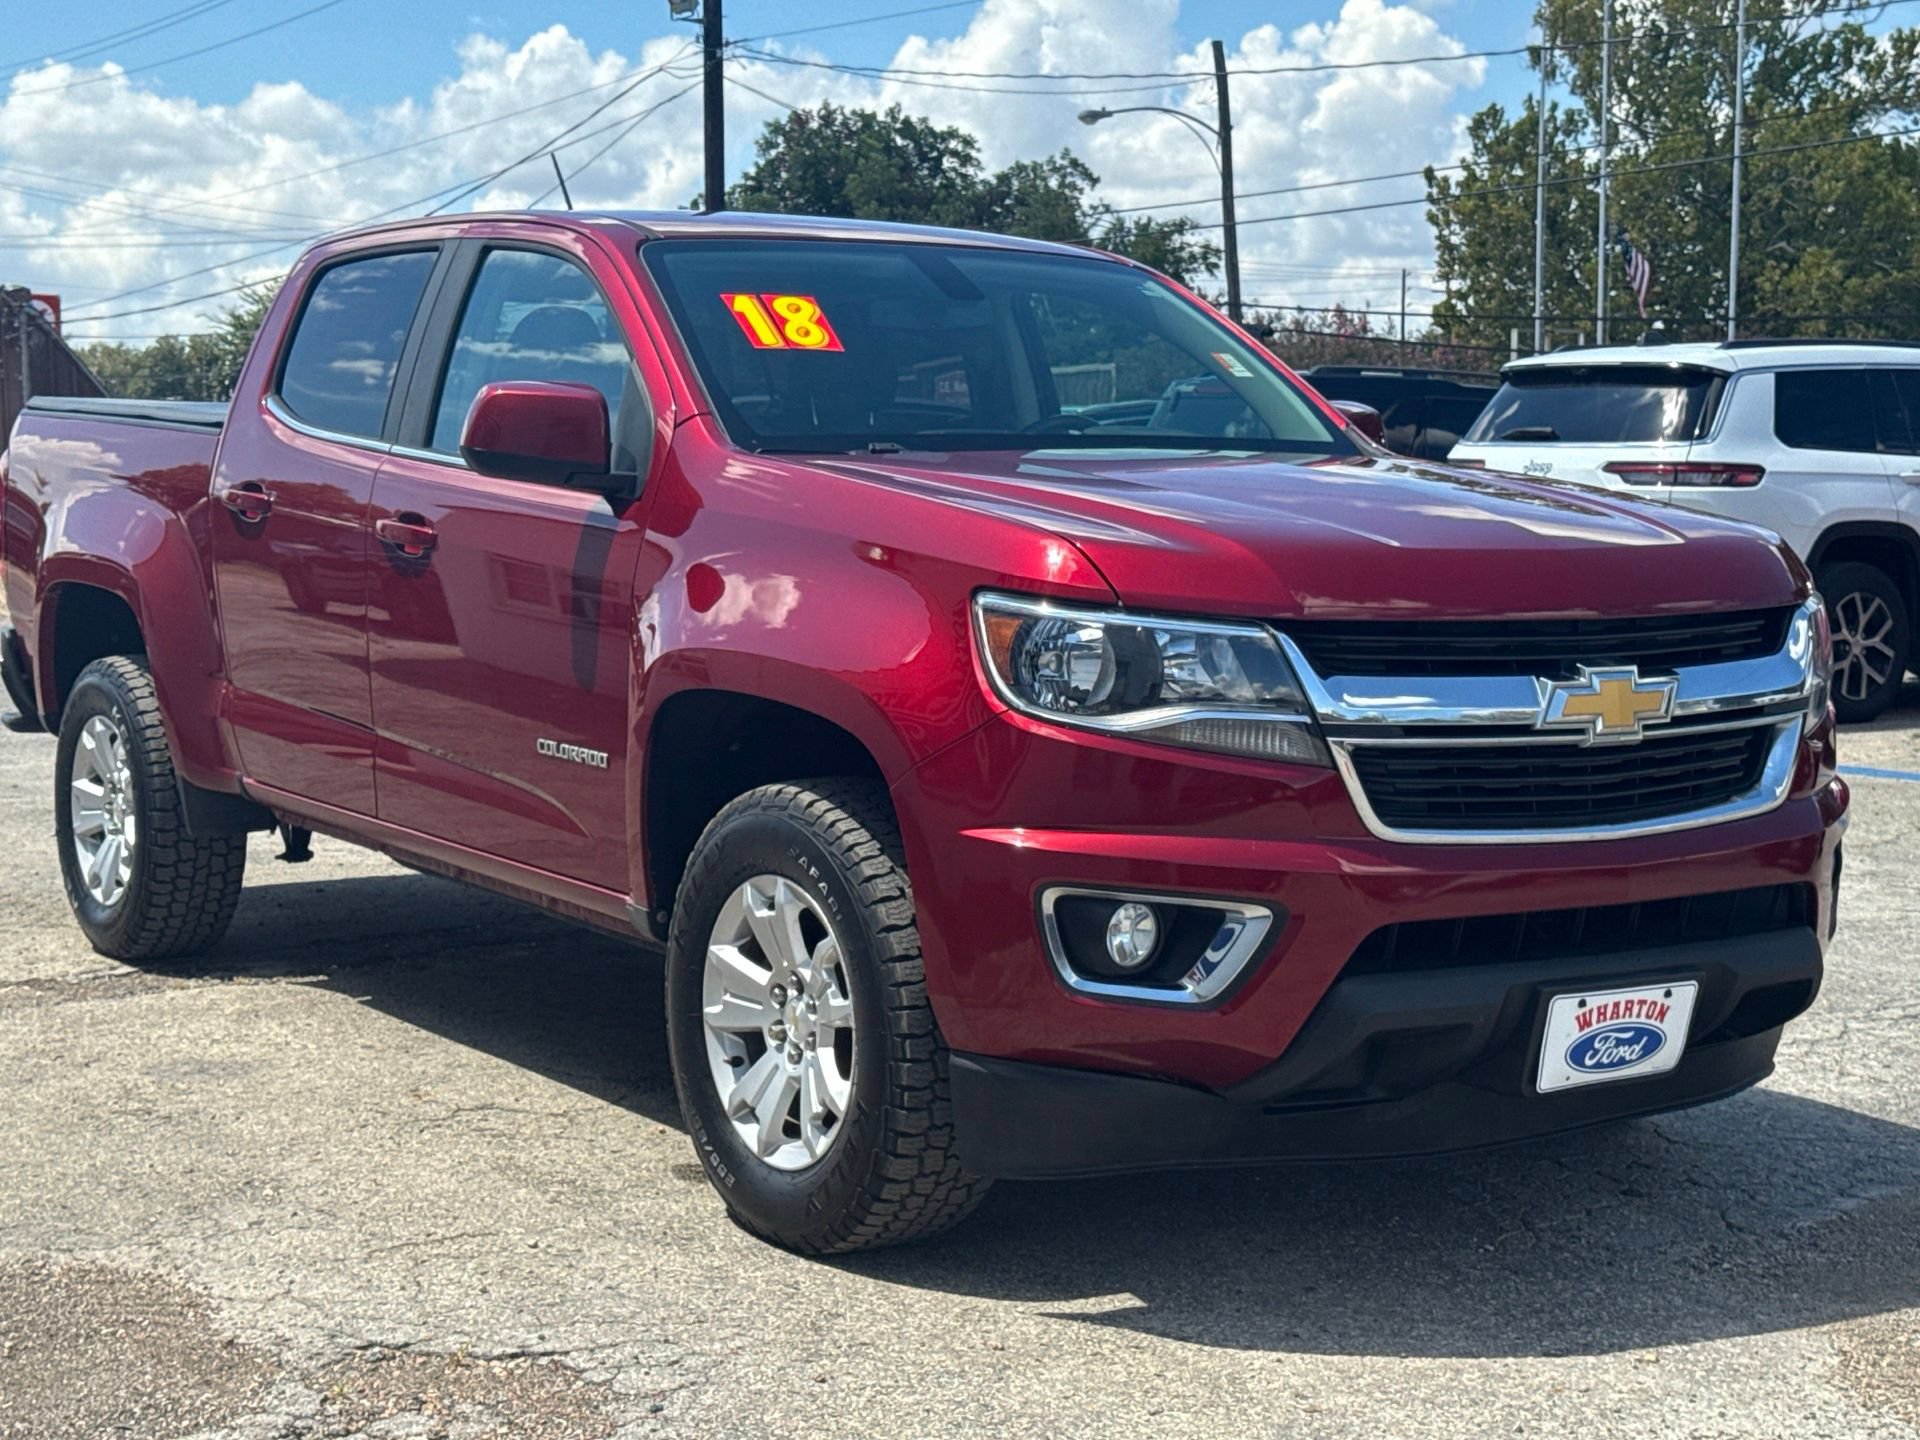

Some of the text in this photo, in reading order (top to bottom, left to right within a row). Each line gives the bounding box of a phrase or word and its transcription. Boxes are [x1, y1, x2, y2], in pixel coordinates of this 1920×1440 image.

[733, 294, 830, 348] 18
[537, 738, 608, 769] COLORADO
[785, 845, 843, 921] SAFARI
[1574, 999, 1672, 1033] WHARTON
[1584, 1030, 1649, 1067] Ford
